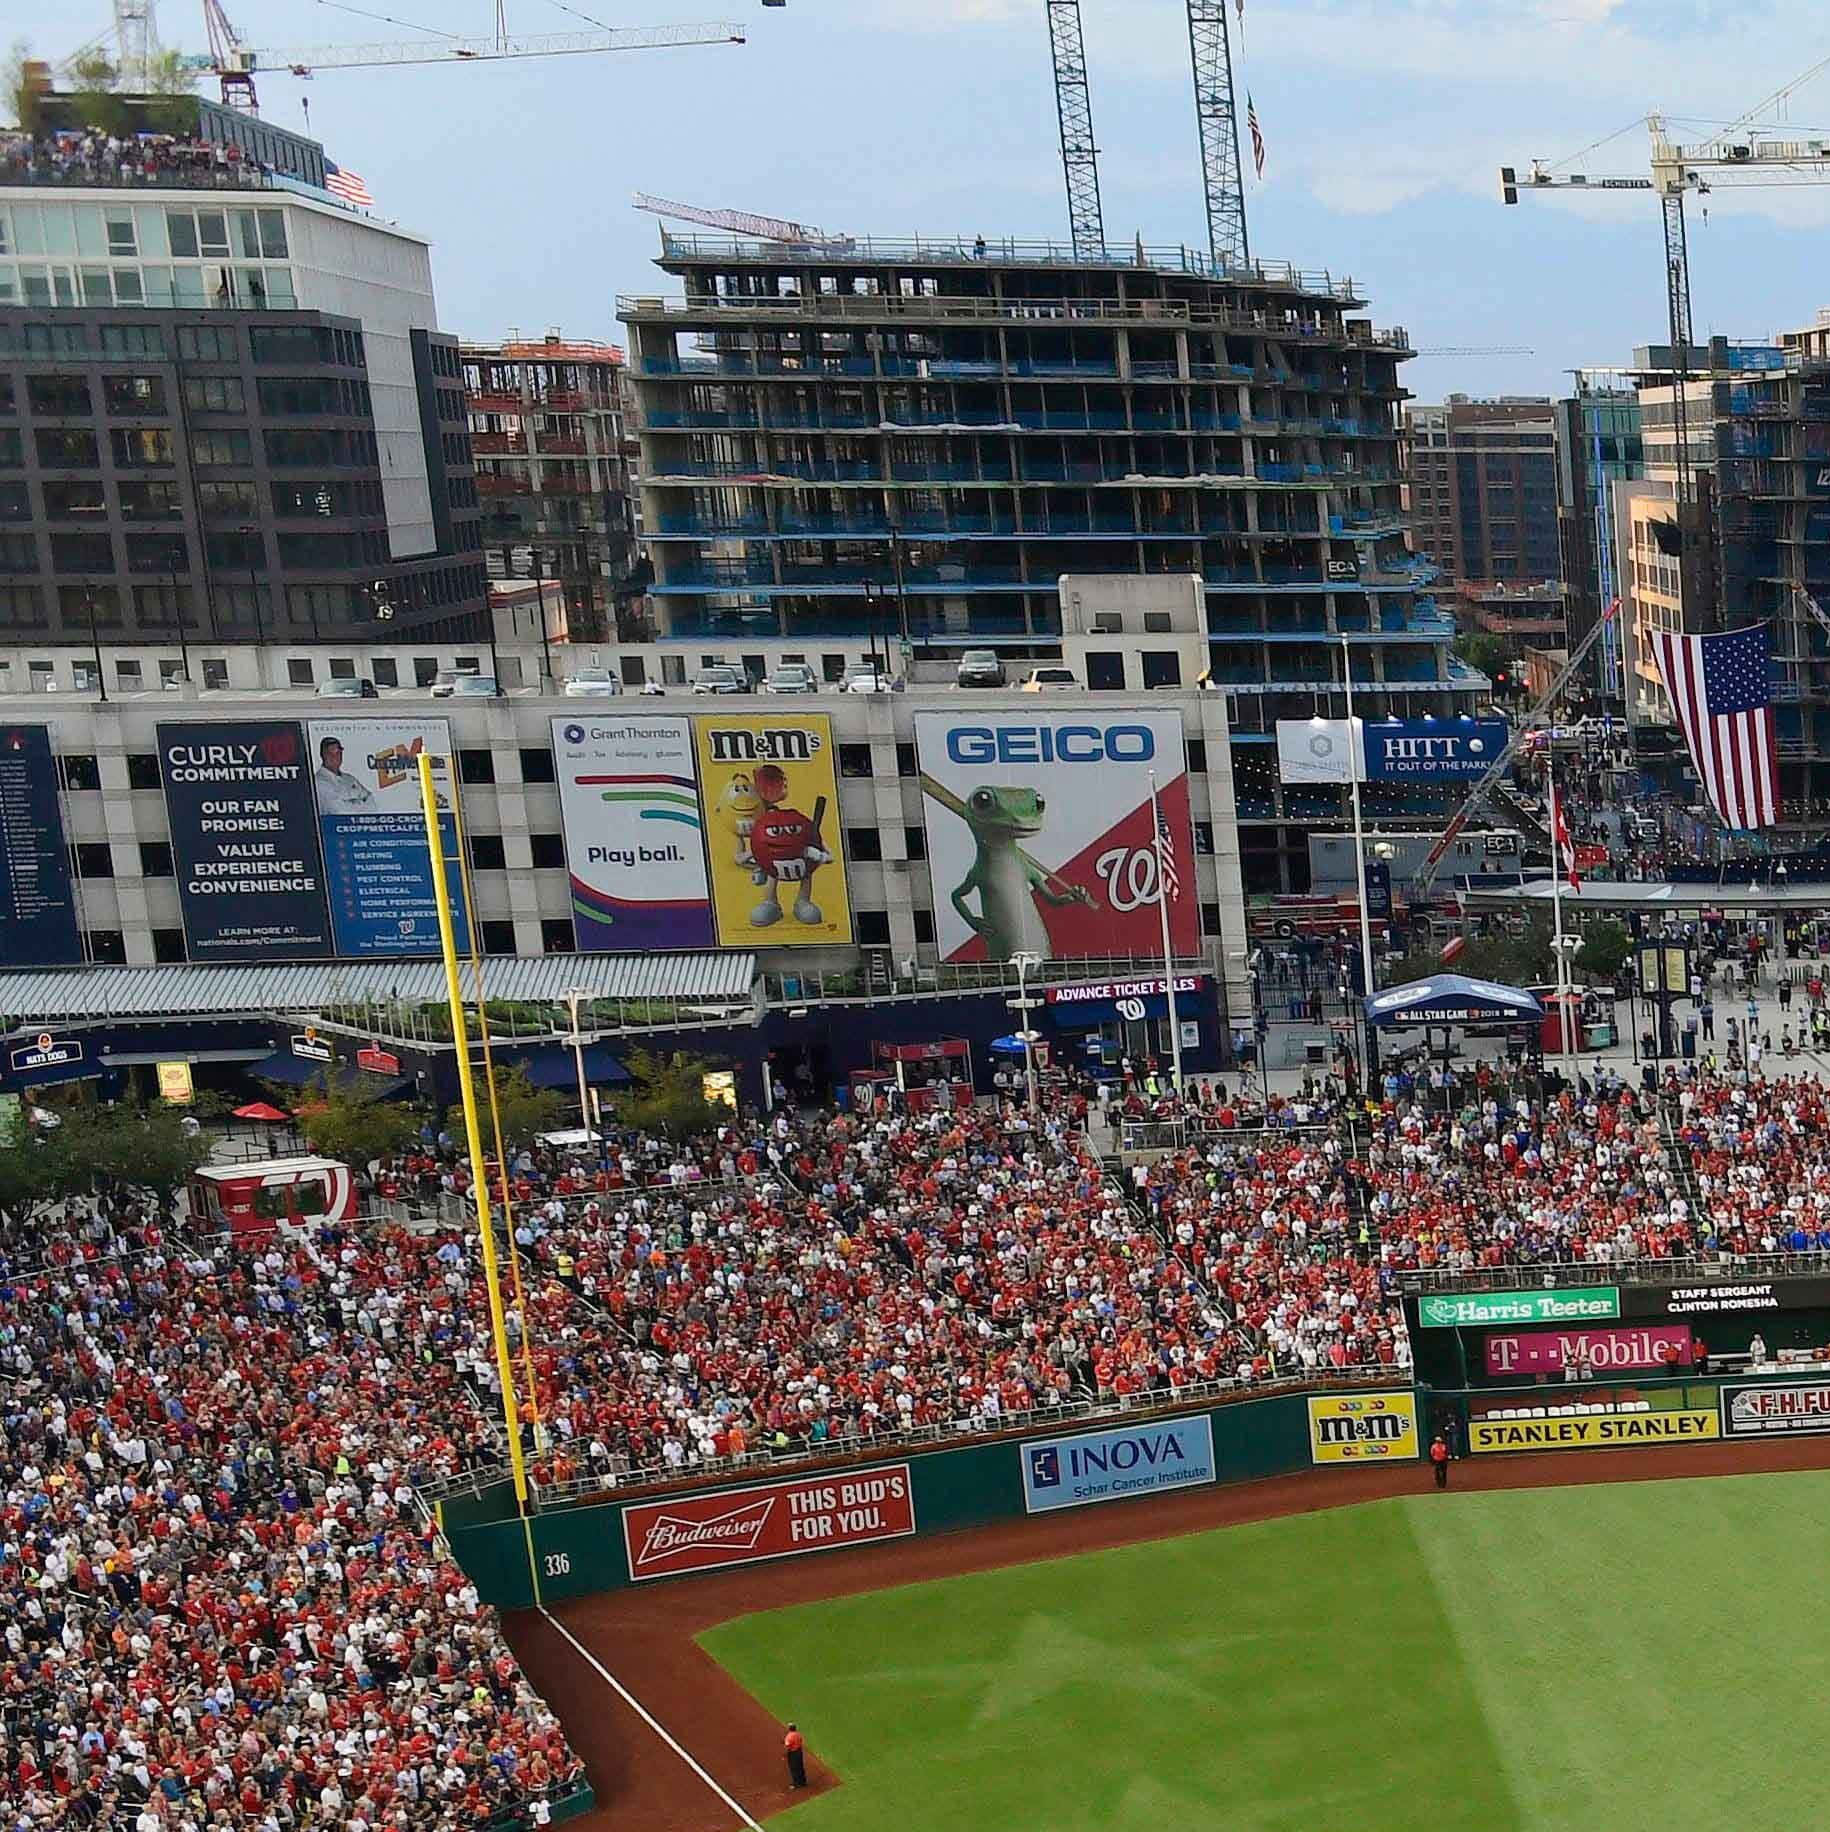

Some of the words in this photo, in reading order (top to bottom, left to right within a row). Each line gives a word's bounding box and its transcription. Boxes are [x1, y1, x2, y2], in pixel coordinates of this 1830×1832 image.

[1328, 562, 1356, 572] ECA
[946, 725, 1154, 764] GEICO
[1384, 736, 1461, 759] HITT
[168, 745, 257, 765] CURLY
[171, 766, 299, 782] COMMITMENT
[1385, 762, 1393, 772] IT
[1397, 761, 1421, 771] OUT
[1423, 761, 1436, 771] OF
[1440, 760, 1460, 770] THE
[201, 801, 239, 814] OUR
[244, 800, 279, 813] FAN
[201, 818, 285, 832] PROMISE:
[217, 844, 275, 857] VALUE
[588, 846, 635, 866] Play
[639, 845, 684, 862] ball.
[194, 861, 304, 875] EXPERIENCE
[188, 879, 315, 894] CONVENIENCE
[218, 926, 248, 936] LEARN
[251, 926, 280, 935] MORE
[1056, 984, 1111, 1002] ADVANCE
[1114, 981, 1155, 998] TICKET
[26, 1051, 47, 1065] NATS
[1672, 1288, 1707, 1300] STAFF
[1710, 1285, 1772, 1299] SERGEANT
[1456, 1301, 1532, 1322] Harris
[1538, 1298, 1613, 1317] Teeter
[1668, 1301, 1719, 1313] CLINTON
[1721, 1297, 1779, 1310] ROMESHA
[1479, 1422, 1589, 1445] STANLEY
[1599, 1416, 1708, 1439] STANLEY
[1070, 1432, 1184, 1477] INOVA
[1073, 1481, 1109, 1498] Schar
[1112, 1474, 1156, 1492] Cancer
[1158, 1465, 1208, 1484] Institute
[787, 1488, 837, 1515] THIS
[840, 1476, 904, 1507] BUD'S
[646, 1518, 762, 1550] Budweiser
[791, 1515, 833, 1542] FOR
[836, 1507, 887, 1534] YOU.
[544, 1553, 570, 1577] 336
